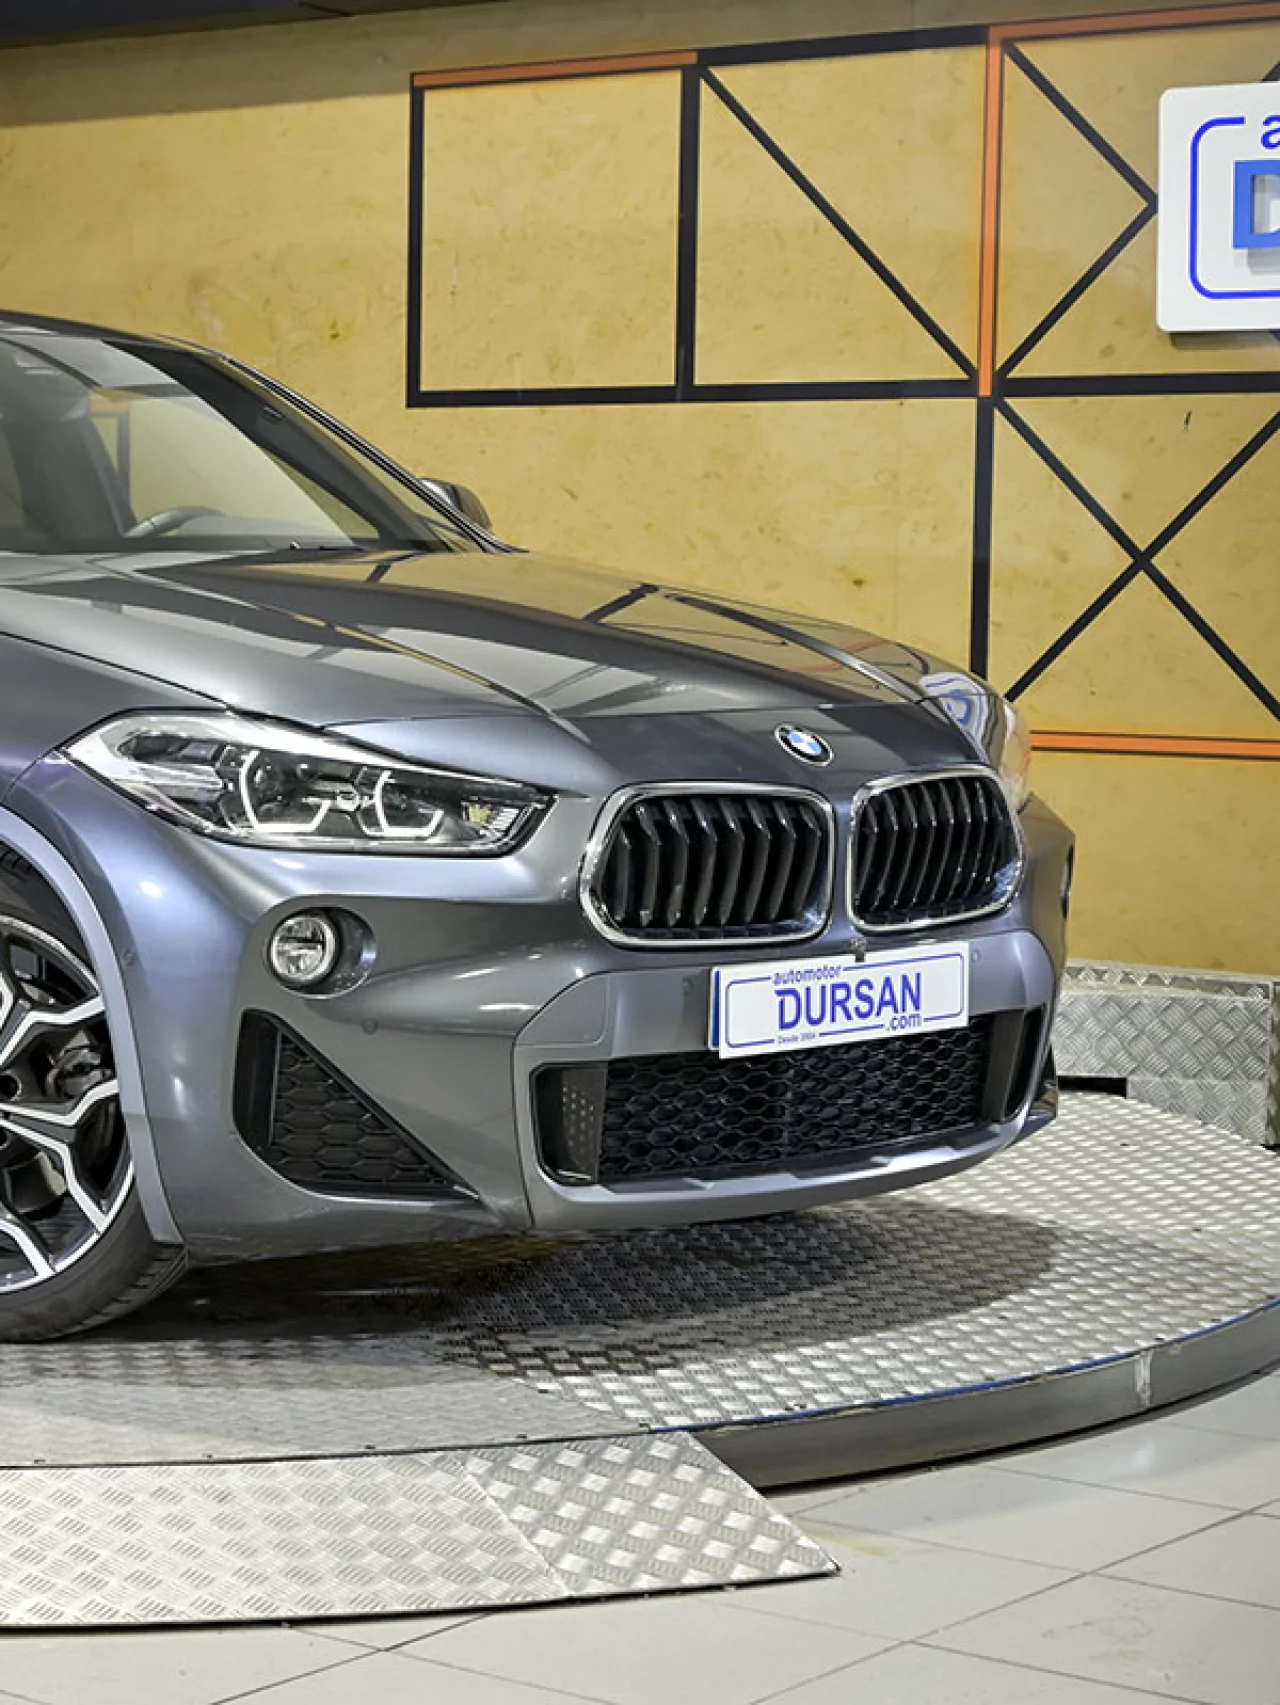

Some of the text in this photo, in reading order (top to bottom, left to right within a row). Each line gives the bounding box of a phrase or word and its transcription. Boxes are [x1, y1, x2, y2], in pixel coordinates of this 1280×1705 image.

[773, 965, 842, 985] automotor
[774, 972, 921, 1031] DURSAN
[886, 1013, 922, 1032] .com
